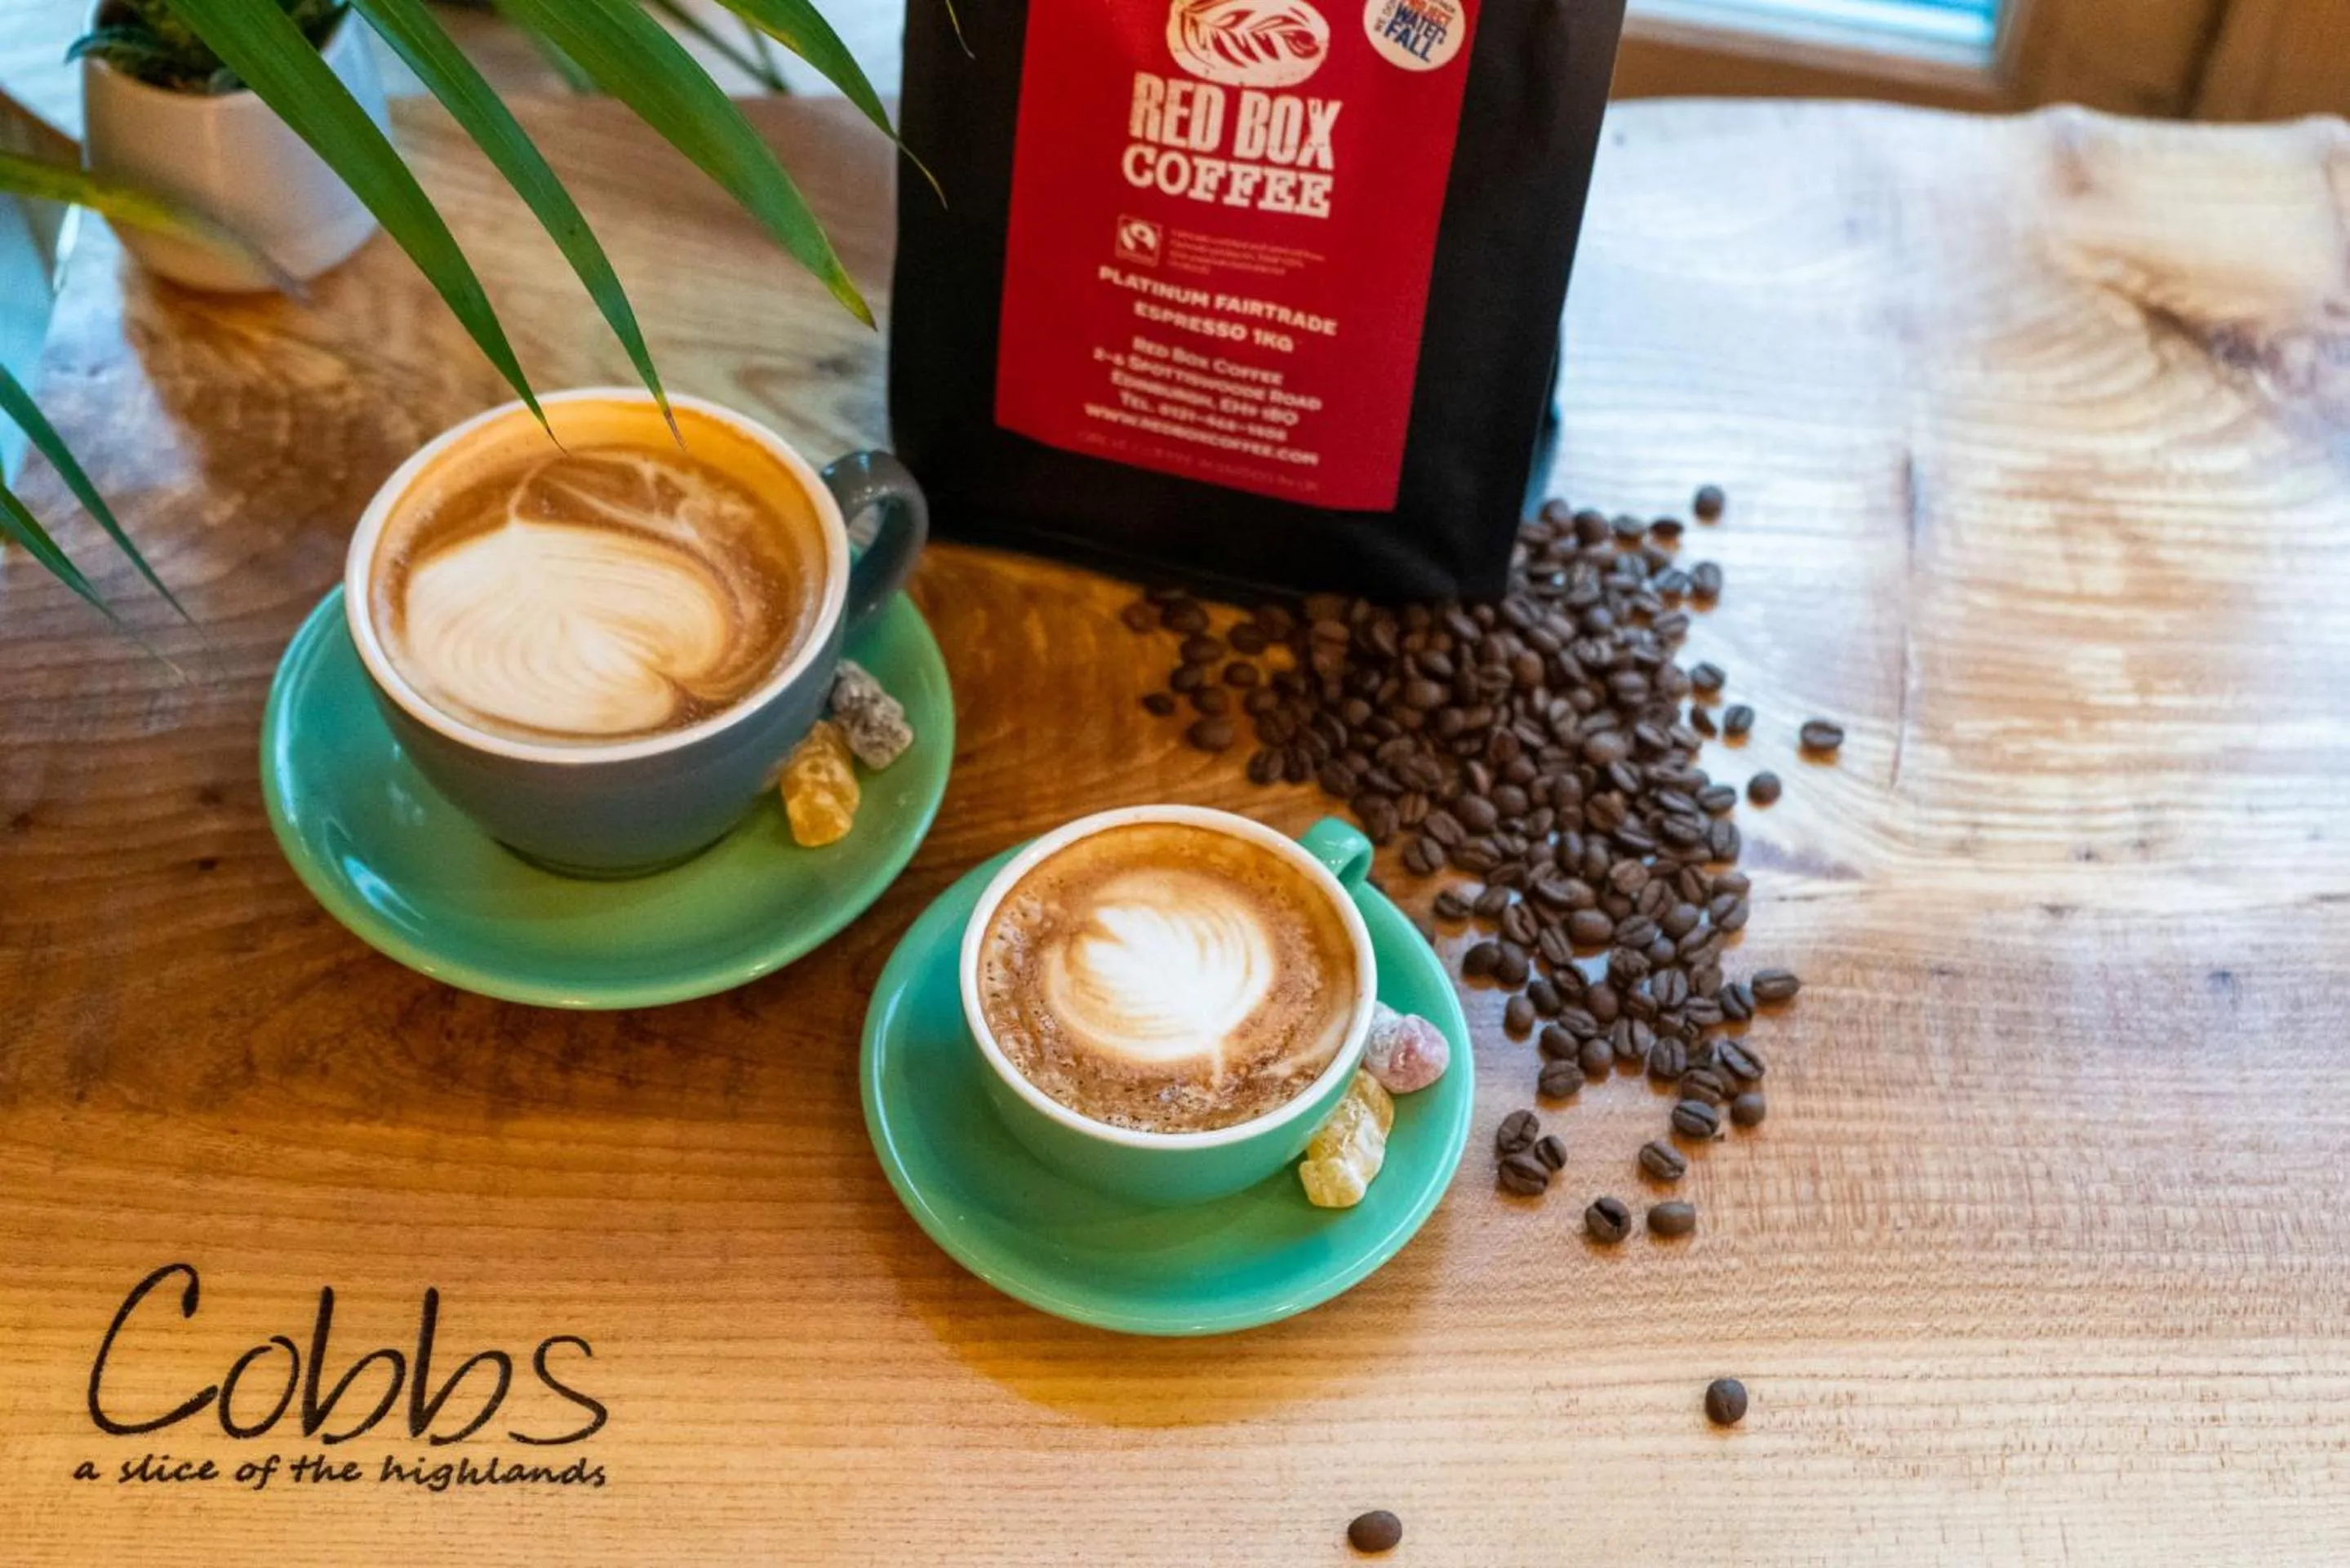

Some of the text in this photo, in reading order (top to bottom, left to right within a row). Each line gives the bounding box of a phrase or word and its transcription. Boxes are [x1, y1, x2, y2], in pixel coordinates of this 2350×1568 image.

[1384, 18, 1431, 63] FALL
[1394, 2, 1447, 45] WATER
[1129, 72, 1343, 171] RED BOX
[1122, 144, 1334, 219] COFFEE
[1099, 265, 1338, 336] PLATINUM FAIRTRADE
[1134, 300, 1294, 353] ESPRESSO 1KG
[87, 1262, 608, 1446] Cobbs
[72, 1453, 606, 1493] a slice of the highlands
